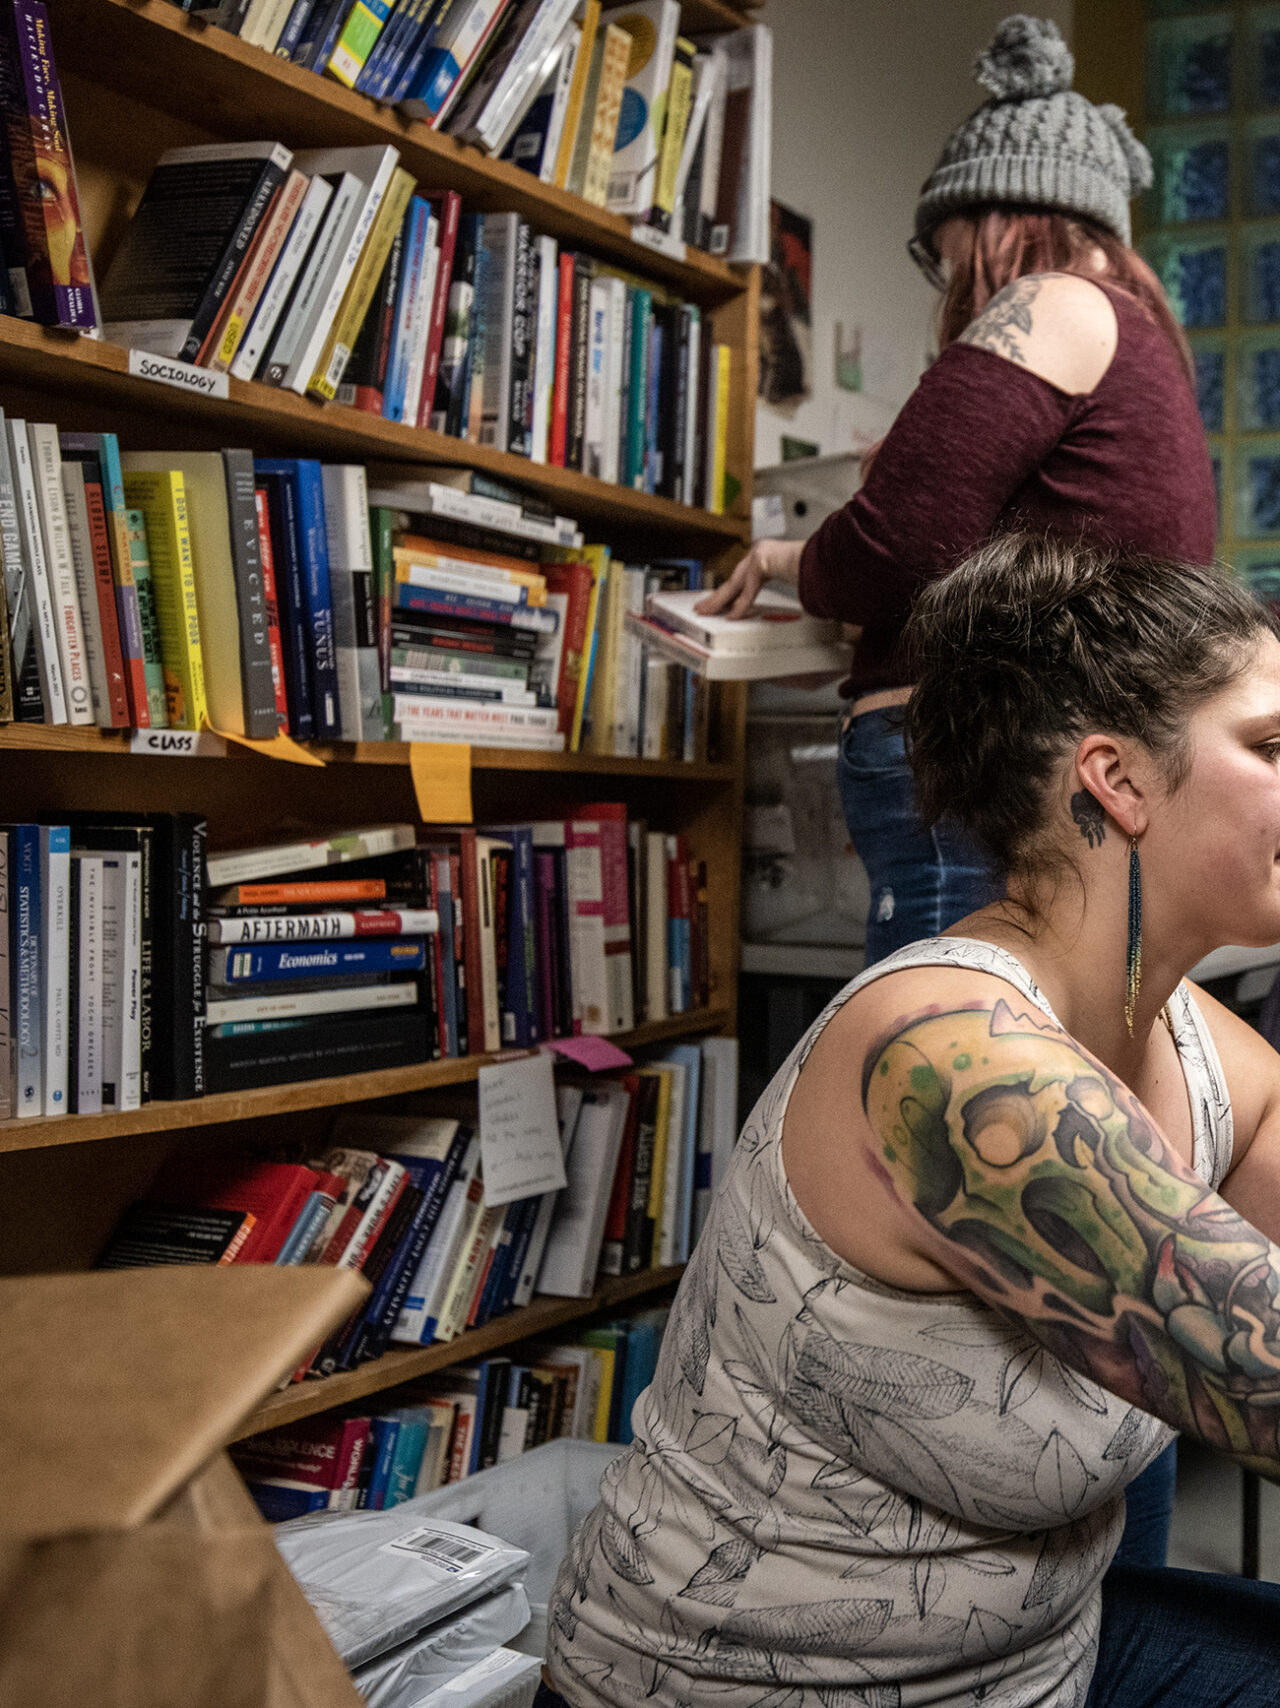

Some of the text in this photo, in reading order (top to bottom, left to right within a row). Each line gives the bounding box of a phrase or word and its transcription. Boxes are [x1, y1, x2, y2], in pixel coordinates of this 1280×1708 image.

[513, 224, 530, 357] WARRIOR COP
[220, 323, 241, 356] USED
[139, 359, 217, 392] SOCIOLOGY
[41, 440, 56, 474] THOMAS
[0, 483, 12, 494] HE
[51, 514, 62, 522] &
[89, 491, 105, 538] GLOBAL
[3, 534, 22, 573] GAME
[53, 524, 68, 560] WILLIAM
[178, 535, 192, 567] WANT
[182, 569, 194, 587] TO
[242, 519, 266, 646] EVICTED
[184, 591, 196, 611] DIE
[35, 558, 43, 576] CLASS
[49, 664, 57, 681] March
[62, 604, 80, 650] FORGOTTEN
[187, 615, 200, 646] POOR
[311, 609, 328, 671] YUNUS
[68, 651, 84, 682] PLACES
[148, 734, 193, 752] CLASS
[191, 822, 206, 889] VIOLENCE
[23, 842, 38, 996] VOGT DICTIONARY OF
[56, 886, 64, 931] OVERKILL
[240, 917, 342, 941] AFTERMATH
[19, 886, 38, 1060] STATISTICS & METHODOLOGY 2
[140, 940, 152, 974] LIFE
[191, 923, 206, 996] STRUGGLE
[278, 949, 339, 970] Economics
[140, 978, 152, 990] &
[129, 1001, 137, 1021] Play
[141, 994, 153, 1052] LABOR
[55, 1046, 61, 1057] MD
[193, 1016, 206, 1092] EXISTENCE
[359, 1172, 402, 1241] LIFE'S WORK
[220, 1223, 252, 1265] CORNEL
